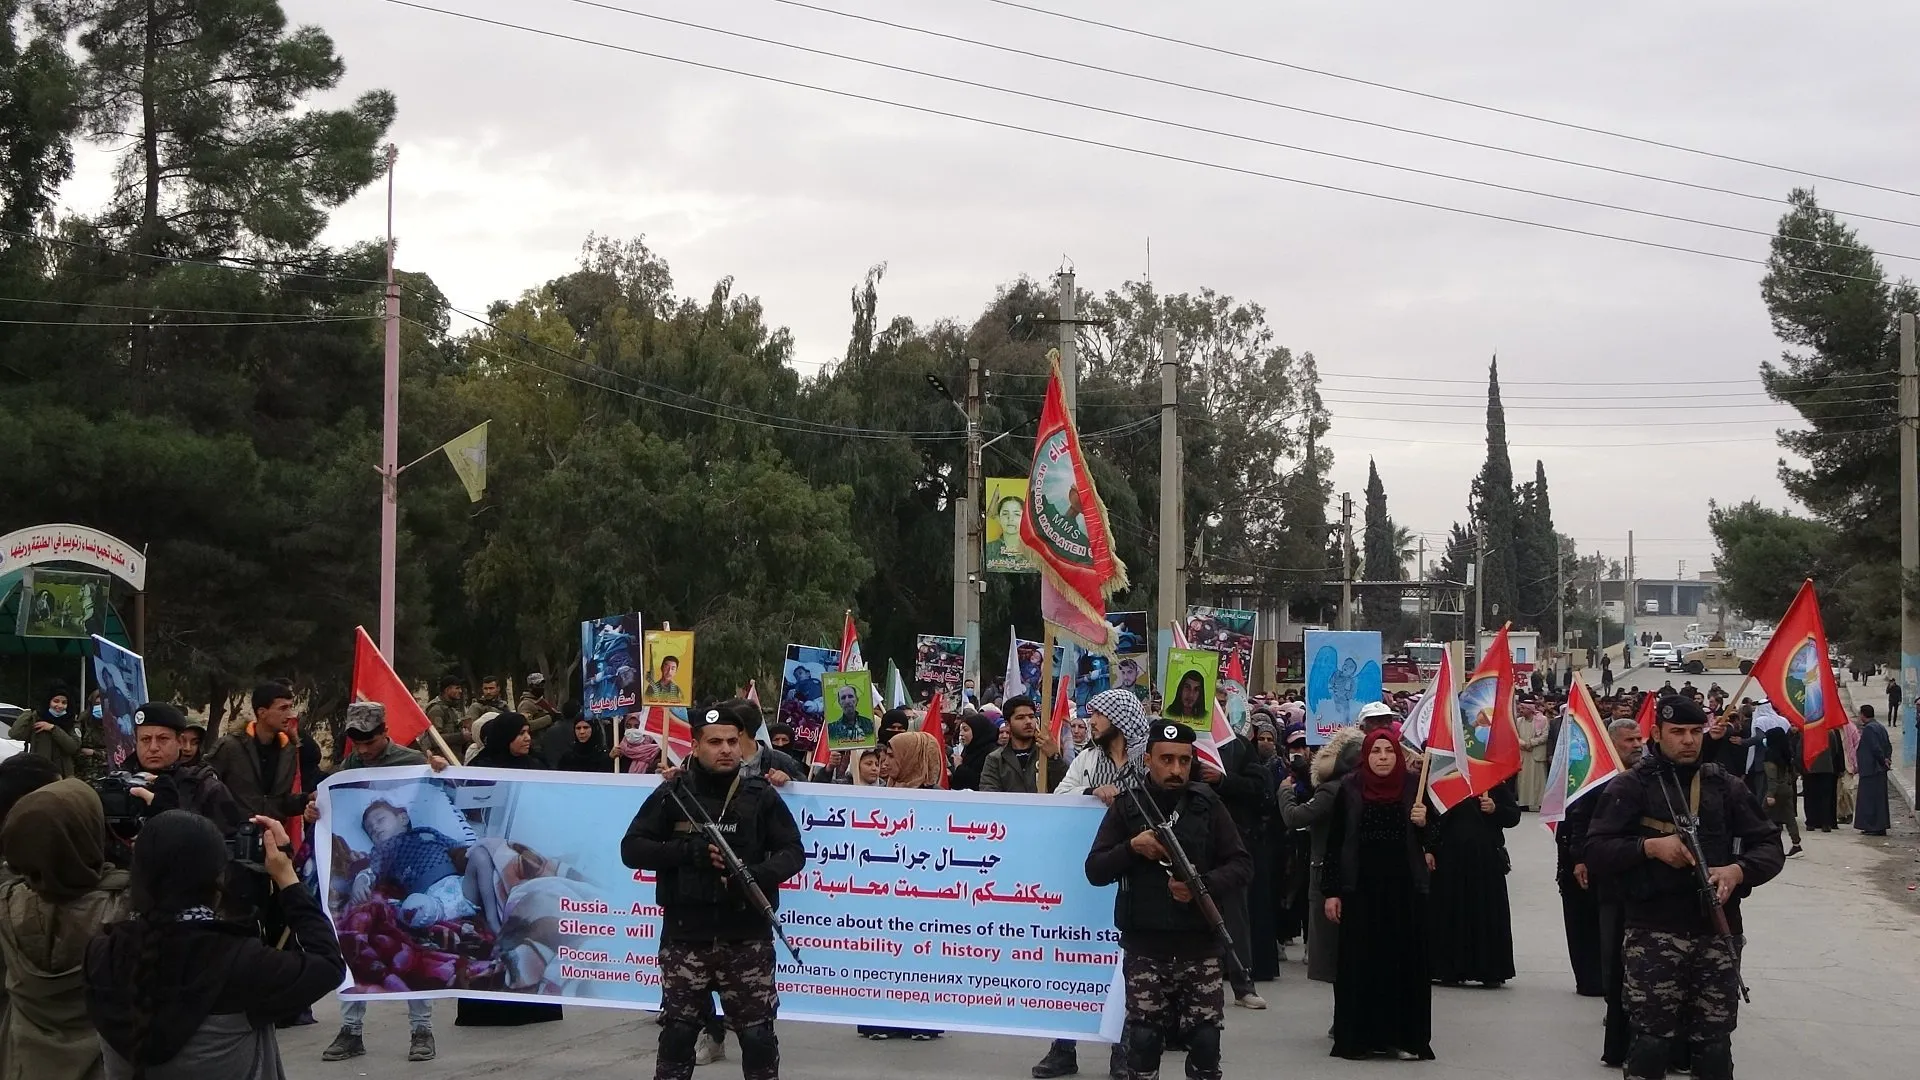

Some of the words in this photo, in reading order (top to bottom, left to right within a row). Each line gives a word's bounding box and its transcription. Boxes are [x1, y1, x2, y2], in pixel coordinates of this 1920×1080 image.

[1052, 513, 1080, 540] MMS
[31, 535, 53, 553] الطبقة
[53, 531, 62, 555] في
[82, 539, 96, 553] نساء
[801, 807, 847, 832] كفوا
[850, 808, 914, 837] أمريكا
[948, 814, 1006, 841] روسيا
[804, 841, 855, 865] الدول
[859, 843, 931, 871] جرائم
[934, 847, 1001, 875] حيال
[813, 870, 890, 898] محاسبة
[894, 879, 968, 900] الصمت
[972, 881, 1062, 911] سيكلفكم
[561, 898, 608, 914] Russia
[631, 902, 665, 917] Ame
[560, 919, 615, 936] Silence
[626, 924, 654, 938] will
[779, 910, 832, 926] silence
[837, 914, 883, 930] about
[888, 917, 914, 932] the
[919, 918, 971, 935] crimes
[976, 921, 994, 936] of
[999, 923, 1025, 938] the
[1030, 924, 1091, 941] Turkish
[1096, 929, 1120, 943] sta
[559, 947, 621, 963] Россия...
[625, 951, 661, 968] Амер
[787, 935, 903, 957] accountability
[913, 940, 932, 955] of
[942, 941, 1000, 962] history
[1012, 946, 1043, 961] and
[561, 965, 631, 981] Молчание
[777, 963, 836, 977] молчать
[841, 968, 849, 978] о
[853, 968, 963, 985] преступлениях
[967, 975, 1042, 990] турецкого
[775, 981, 881, 998] ветственности
[886, 989, 930, 1003] перед
[934, 992, 1001, 1008] историей
[1007, 997, 1015, 1006] и
